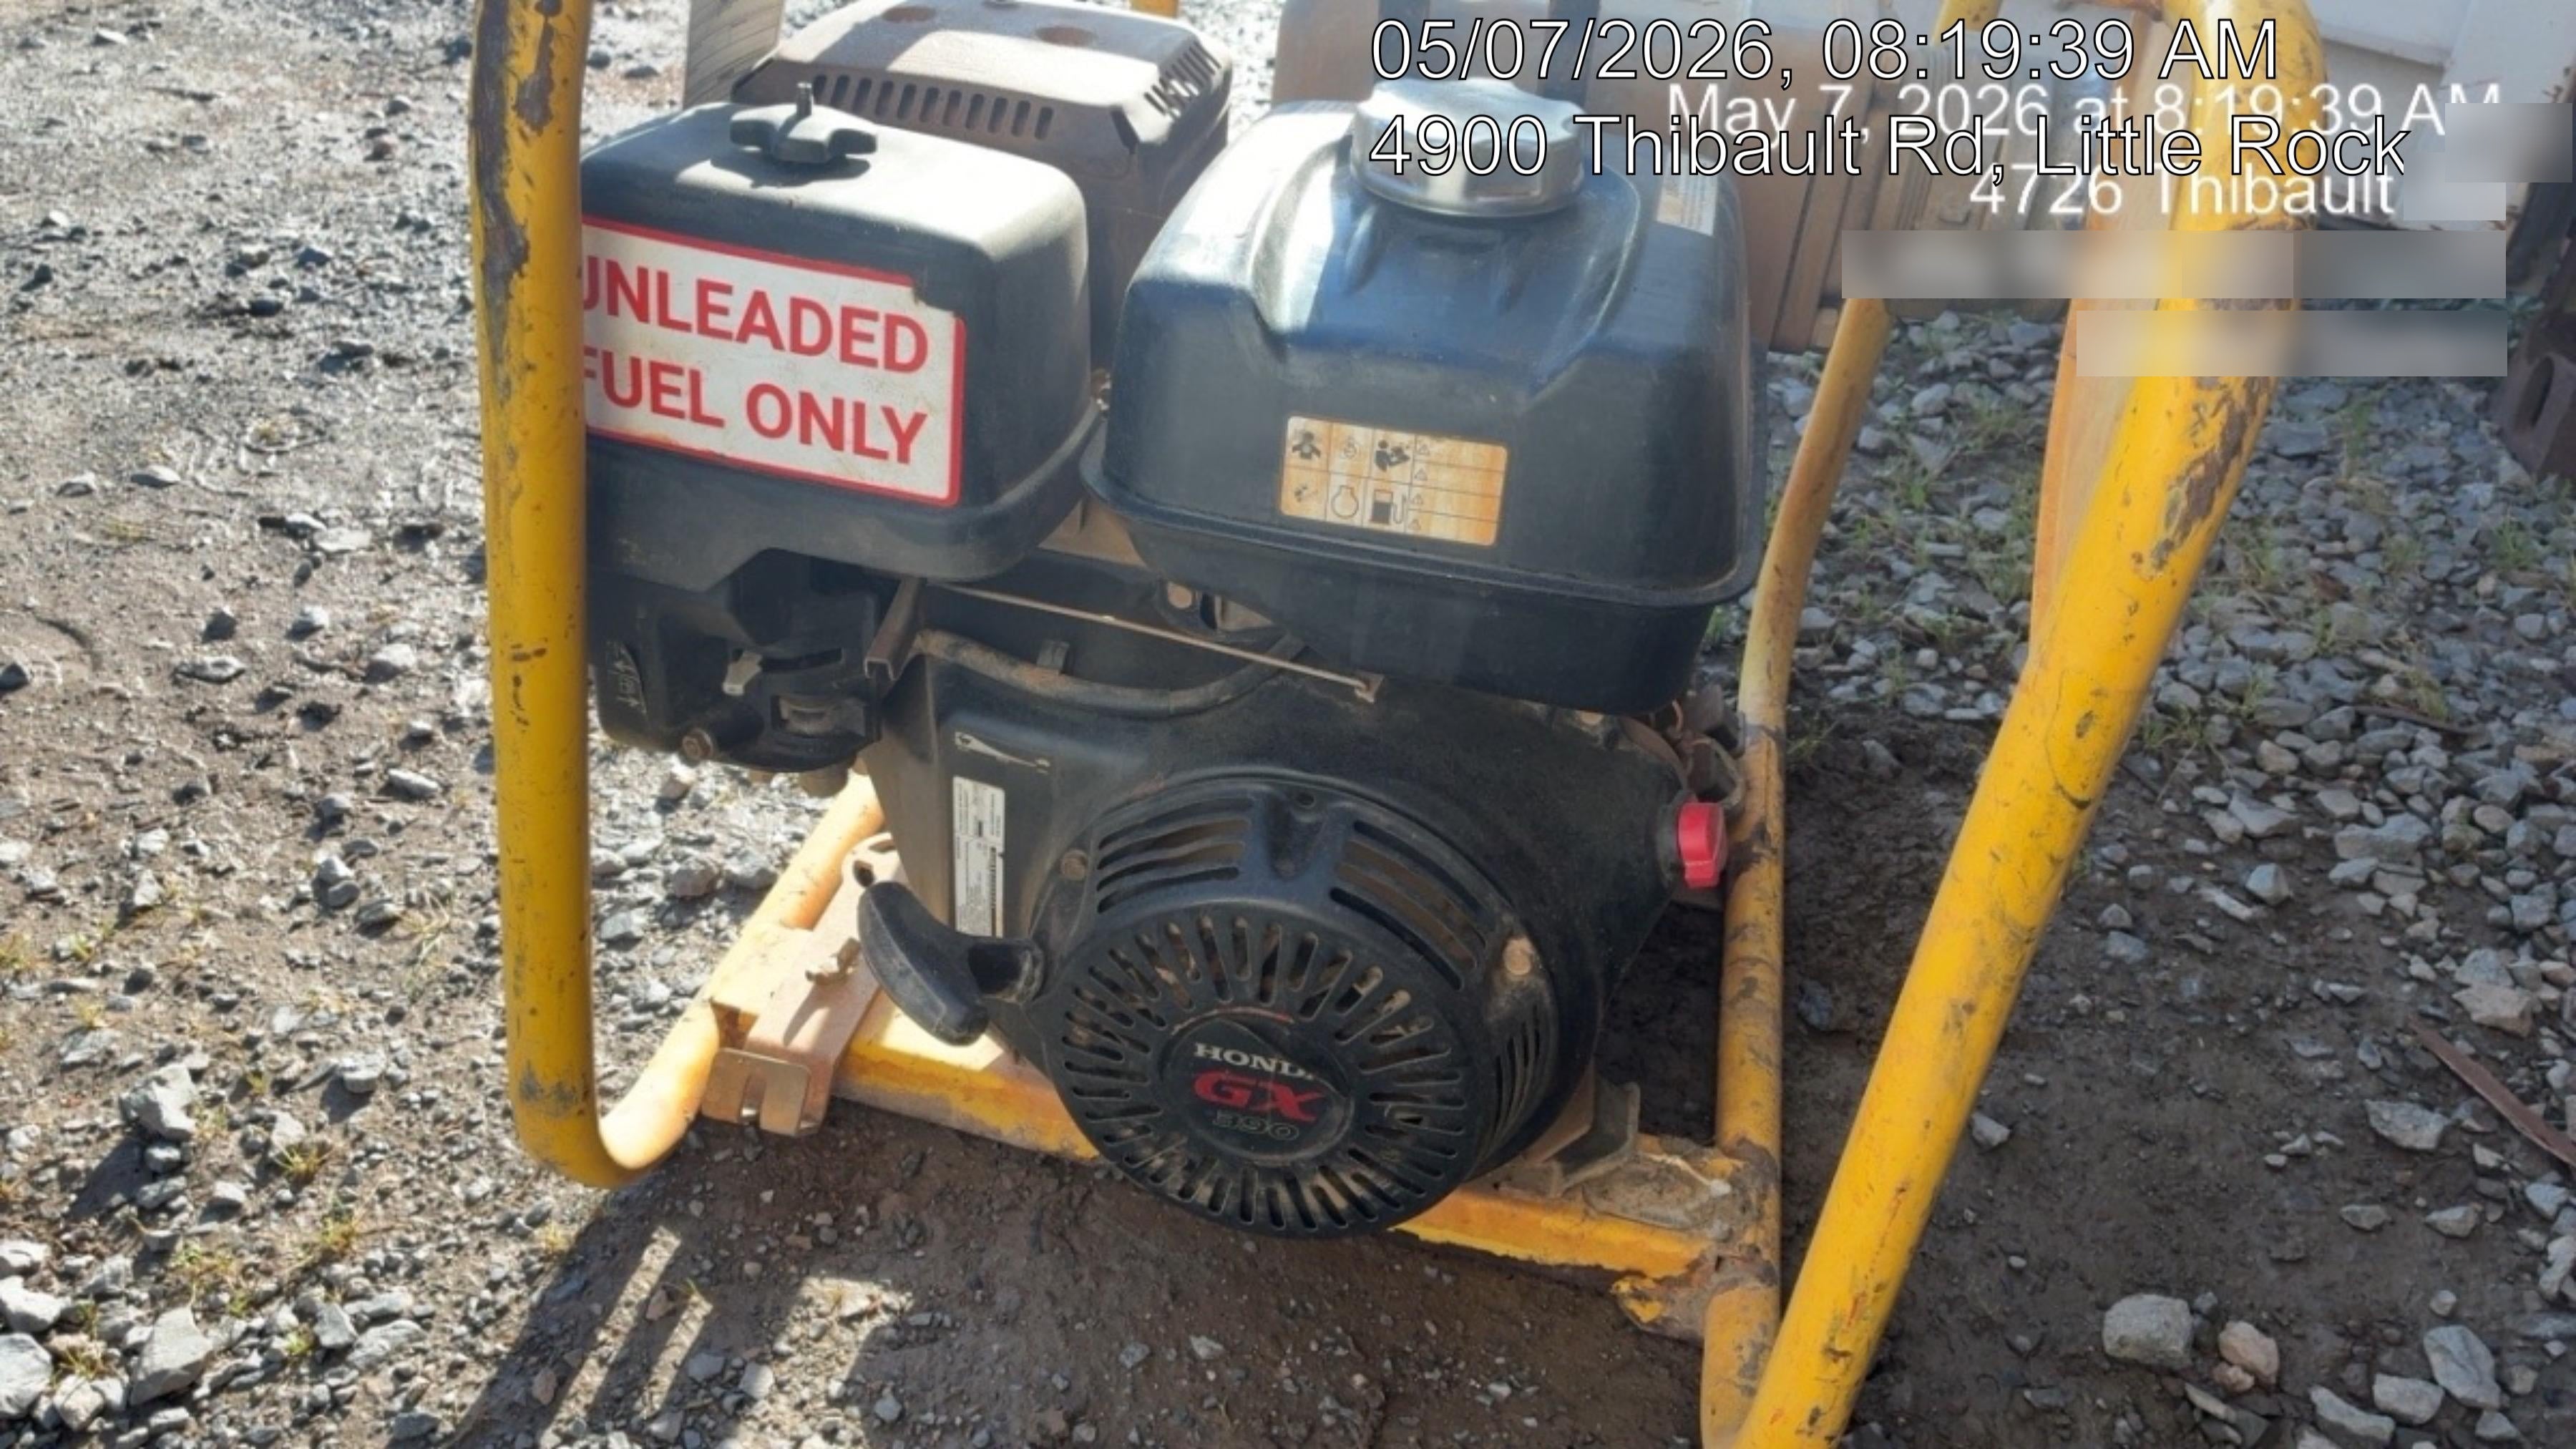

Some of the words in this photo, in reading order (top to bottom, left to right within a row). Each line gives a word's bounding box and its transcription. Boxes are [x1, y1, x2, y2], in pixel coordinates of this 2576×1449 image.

[746, 383, 927, 465] ONLY
[1194, 1042, 1314, 1080] HOND
[1194, 1069, 1326, 1122] GX
